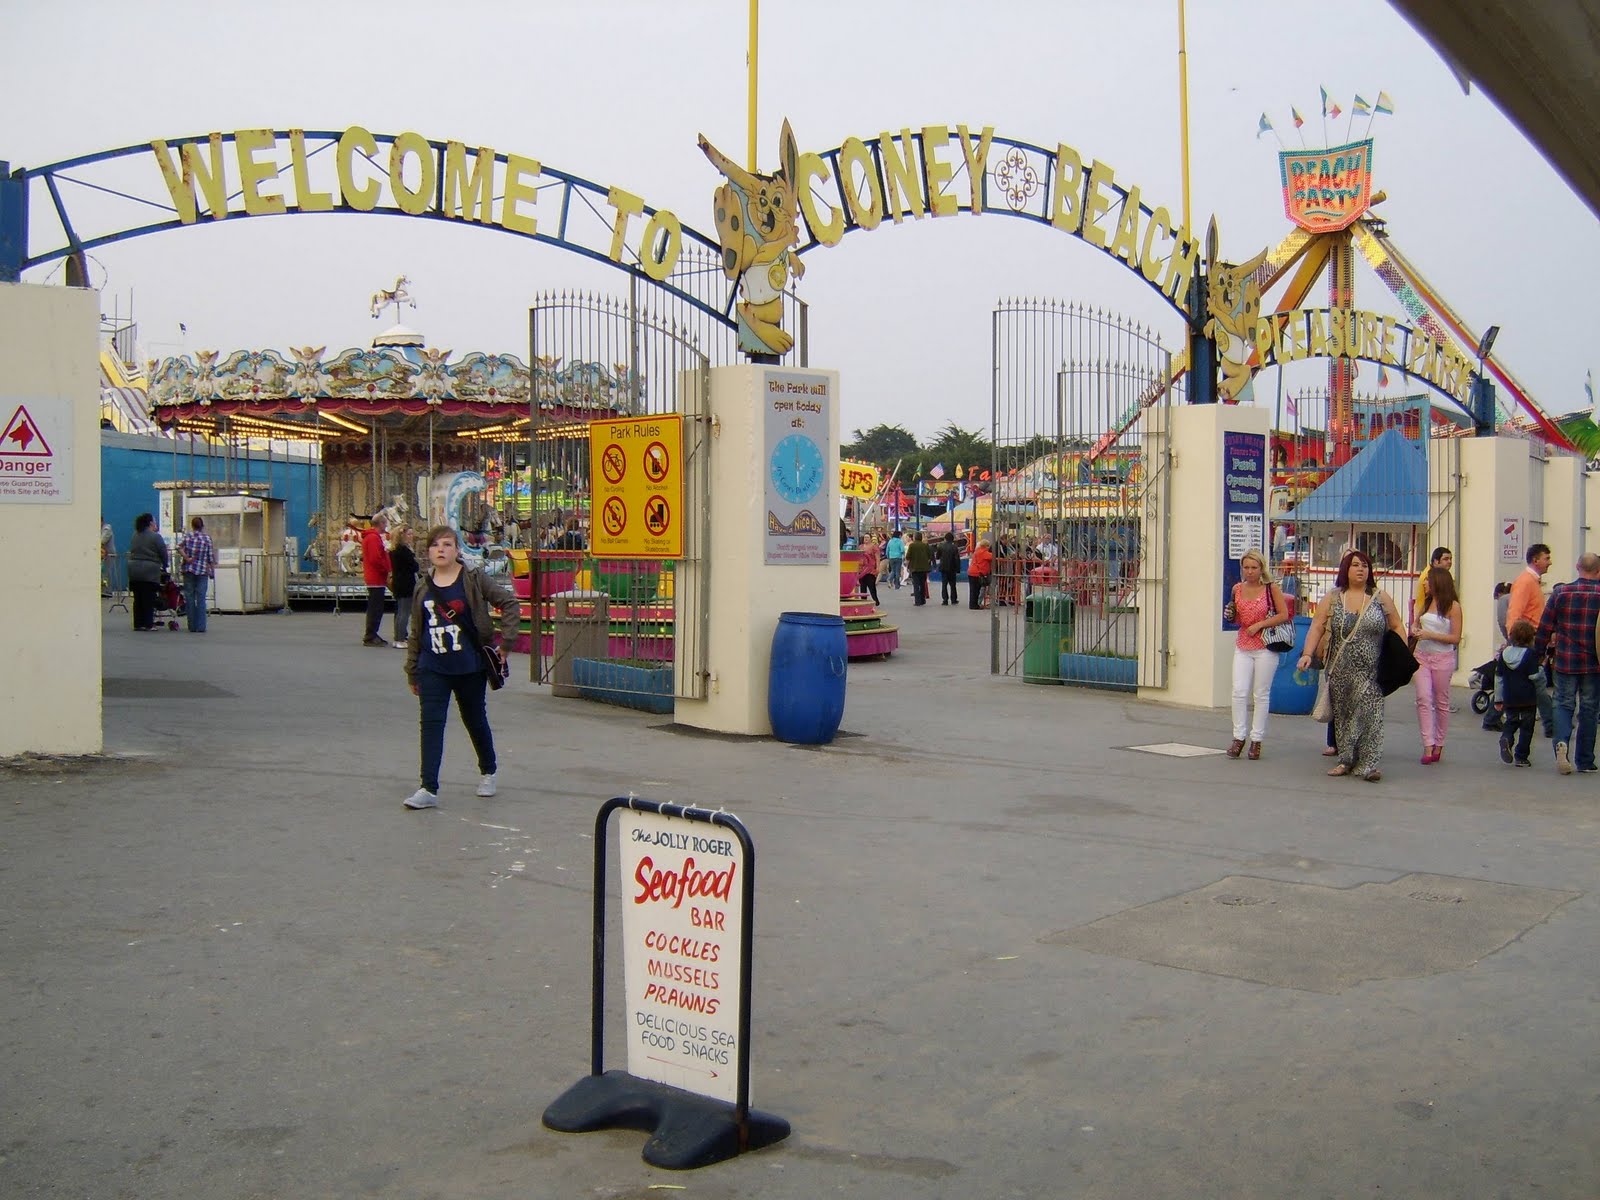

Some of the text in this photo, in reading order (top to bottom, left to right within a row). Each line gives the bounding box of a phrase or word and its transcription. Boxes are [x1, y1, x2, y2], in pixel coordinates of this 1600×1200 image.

[1291, 154, 1361, 191] BEACH
[150, 126, 682, 280] WELCOME TO
[1294, 184, 1361, 212] PARTY
[798, 124, 1200, 304] CONEY BEACH
[1255, 307, 1475, 406] PLEASURE PARK
[768, 380, 826, 396] The Park will
[774, 400, 822, 414] open today
[611, 424, 660, 439] Park Rules
[791, 417, 805, 428] at:
[1353, 409, 1420, 441] EACH
[1232, 457, 1257, 471] Park
[35, 480, 53, 488] Dogs
[840, 468, 873, 494] UPS
[1226, 473, 1262, 490] Opening
[794, 515, 810, 531] Nice
[1230, 514, 1262, 523] THIS WEEK
[423, 600, 438, 626] I
[429, 624, 462, 654] NY
[632, 828, 734, 857] The JOLLY ROGER
[634, 856, 736, 909] Seafood
[691, 907, 725, 931] BAR
[645, 931, 721, 962] COCKLES
[648, 959, 719, 990] MUSSELS
[644, 983, 720, 1015] PRAWNS
[635, 1011, 736, 1049] DELICIOUS SEA
[641, 1030, 729, 1065] FOOD SNACKS
